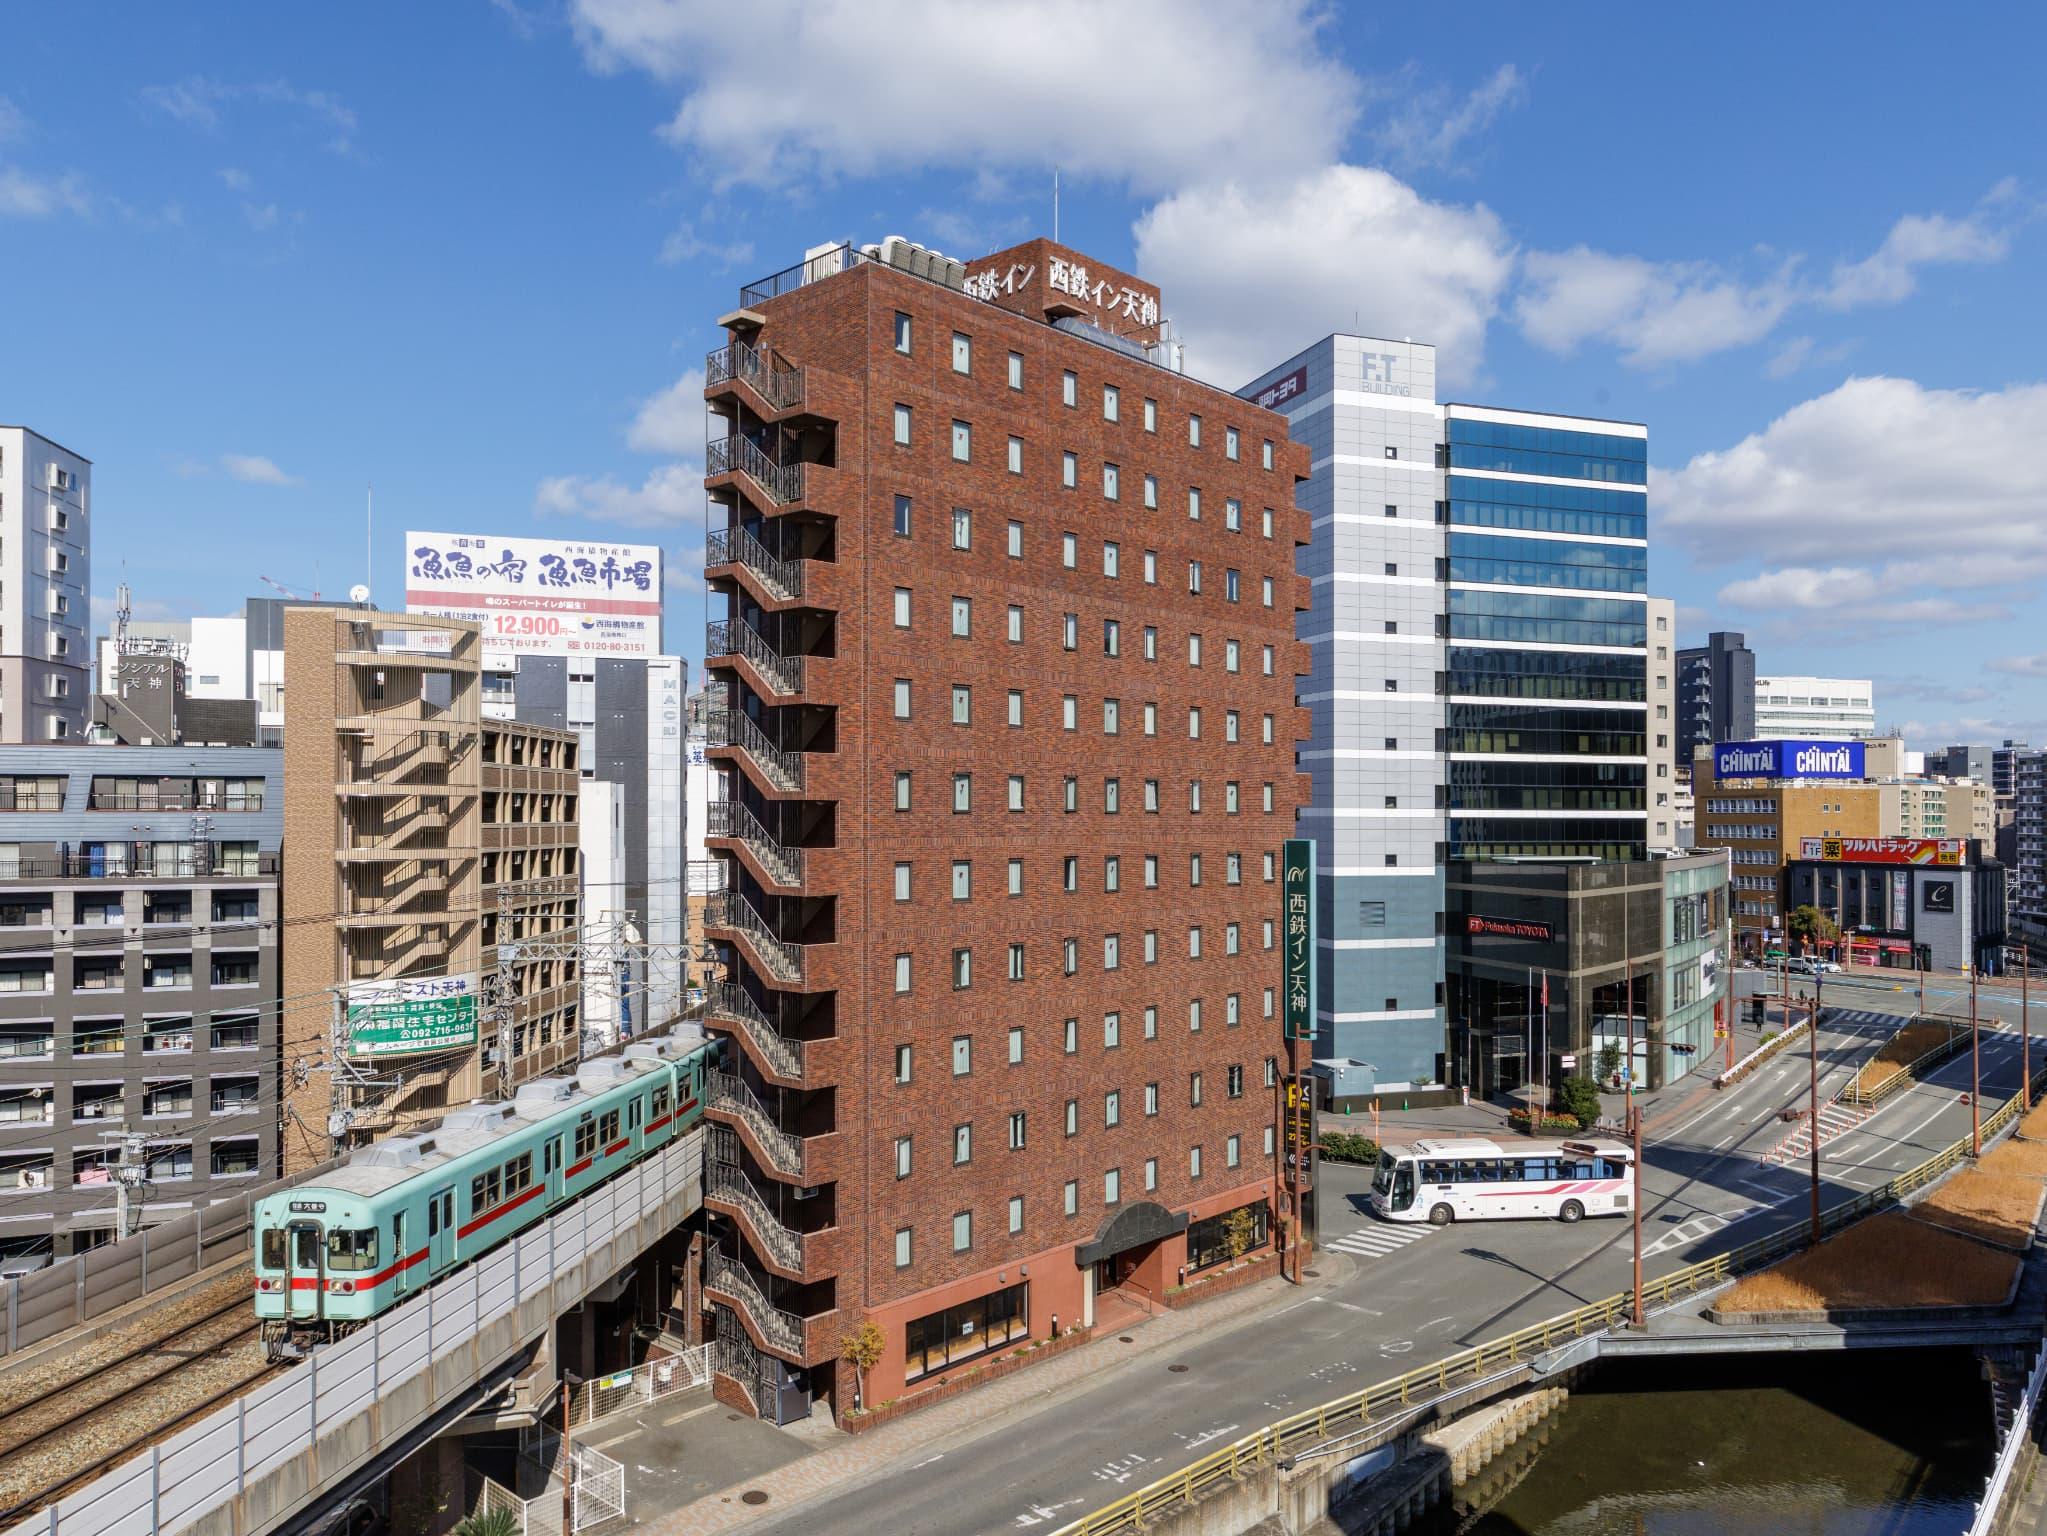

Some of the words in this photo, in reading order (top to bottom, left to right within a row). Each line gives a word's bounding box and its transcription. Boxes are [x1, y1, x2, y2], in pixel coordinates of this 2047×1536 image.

[1049, 255, 1158, 327] 西鉄イン天神
[1362, 381, 1410, 397] BUILDING
[538, 554, 652, 590] 魚魚市場
[119, 662, 170, 674] ソシアル
[127, 677, 162, 690] 天神
[1796, 746, 1851, 773] CHINTAI
[1810, 847, 1821, 856] 1F
[1824, 841, 1840, 858] 薬
[1842, 839, 1922, 854] ツルハドラッグ
[1516, 924, 1549, 939] TOYOTA
[1289, 893, 1308, 1013] 西鉄イン天神
